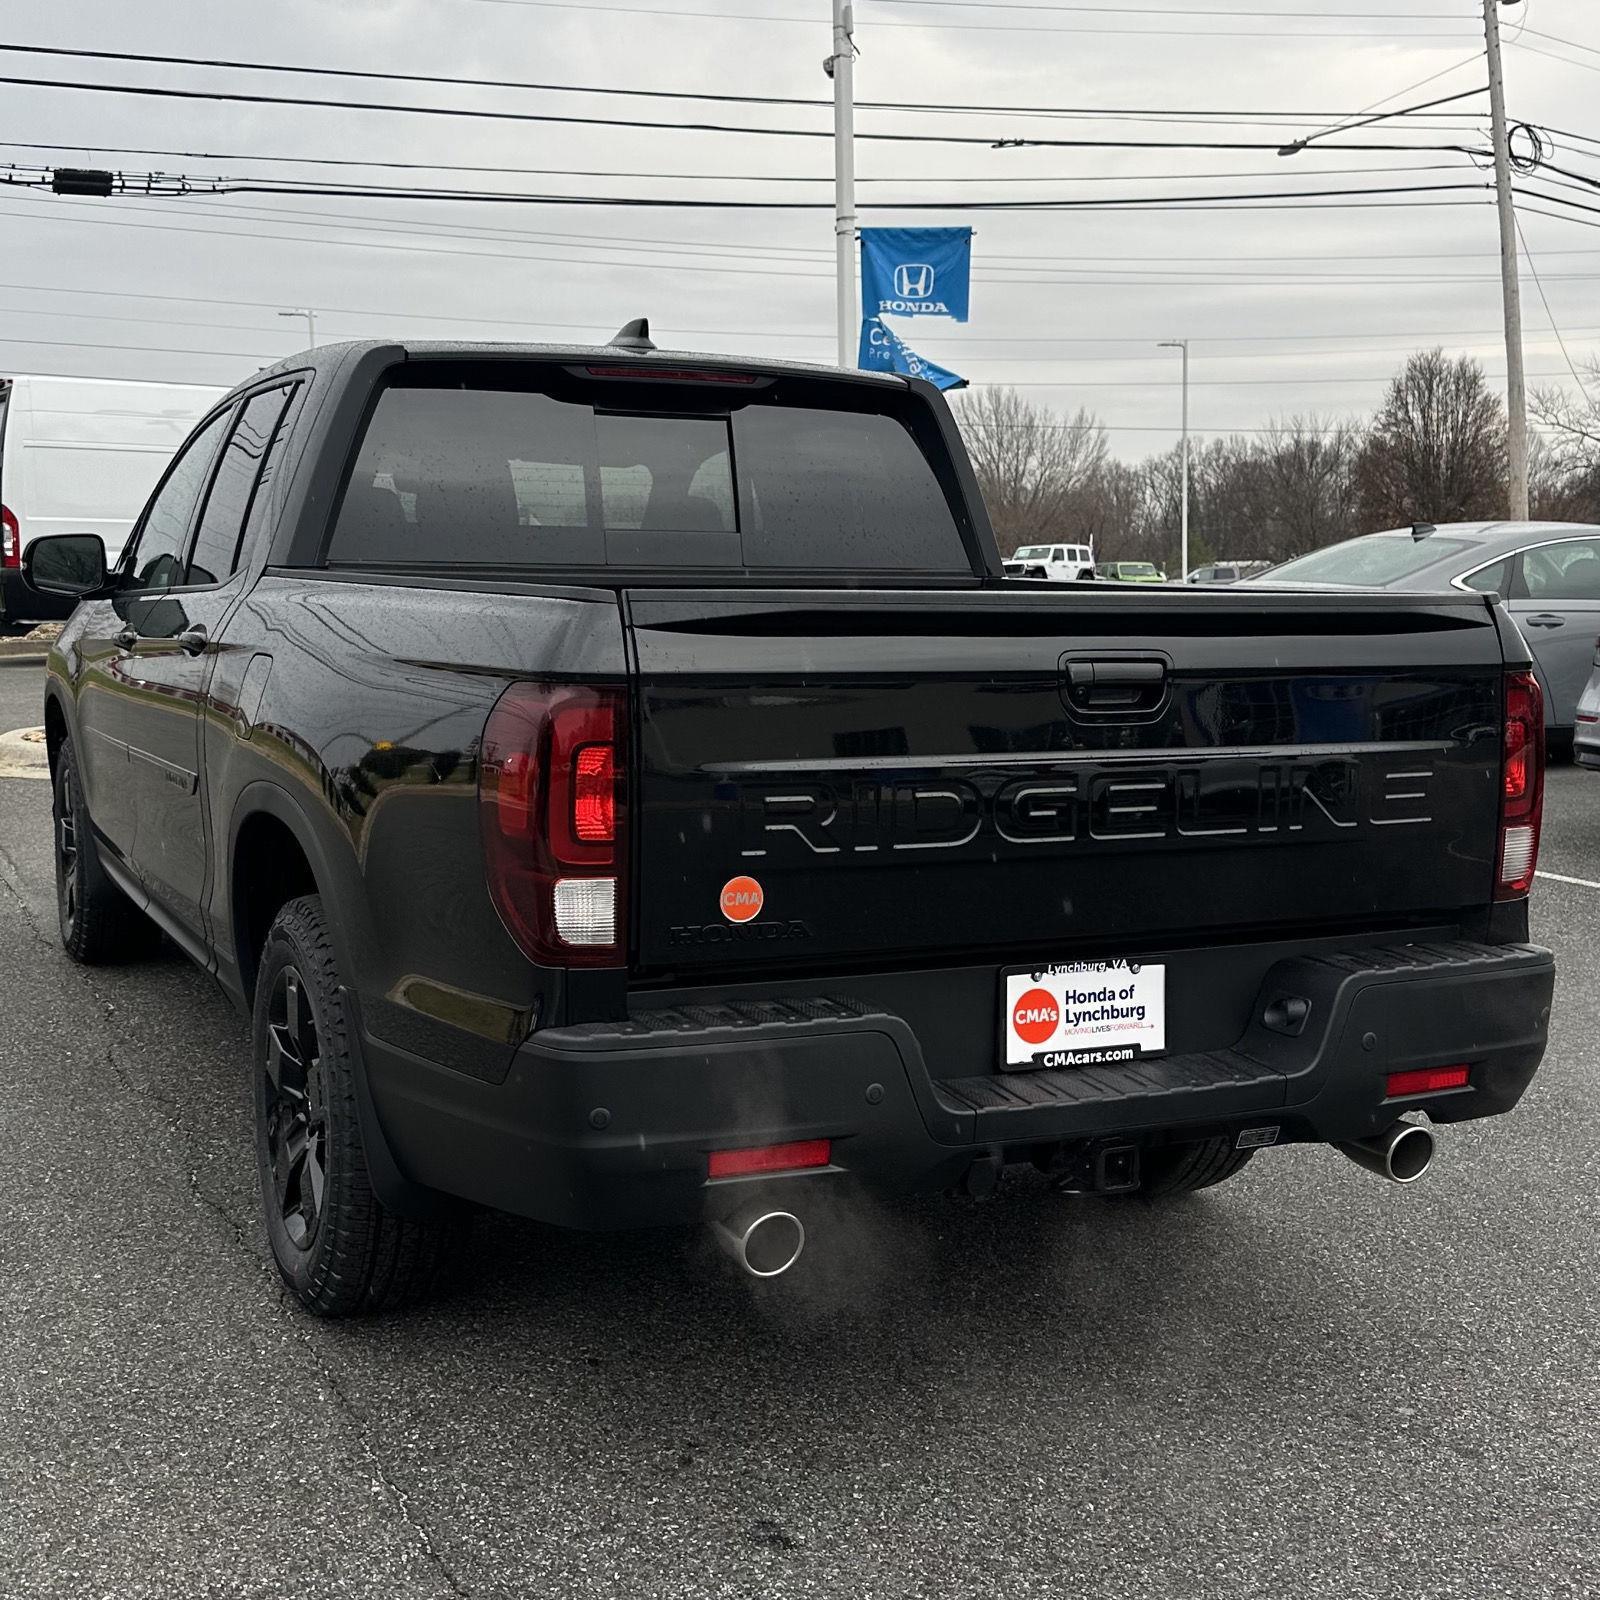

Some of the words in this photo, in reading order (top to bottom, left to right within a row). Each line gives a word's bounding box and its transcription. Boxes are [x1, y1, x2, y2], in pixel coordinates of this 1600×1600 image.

[878, 300, 949, 313] HONDA
[741, 767, 1434, 856] RIDGELINE
[723, 891, 761, 906] CMA
[669, 920, 814, 944] HONDA
[1112, 959, 1128, 970] VA
[1065, 987, 1116, 1005] Honda
[1118, 984, 1135, 1000] of
[1015, 1007, 1058, 1025] CMA's
[1065, 1004, 1146, 1027] Lynchburg
[1043, 1048, 1134, 1068] CMAcars.com
